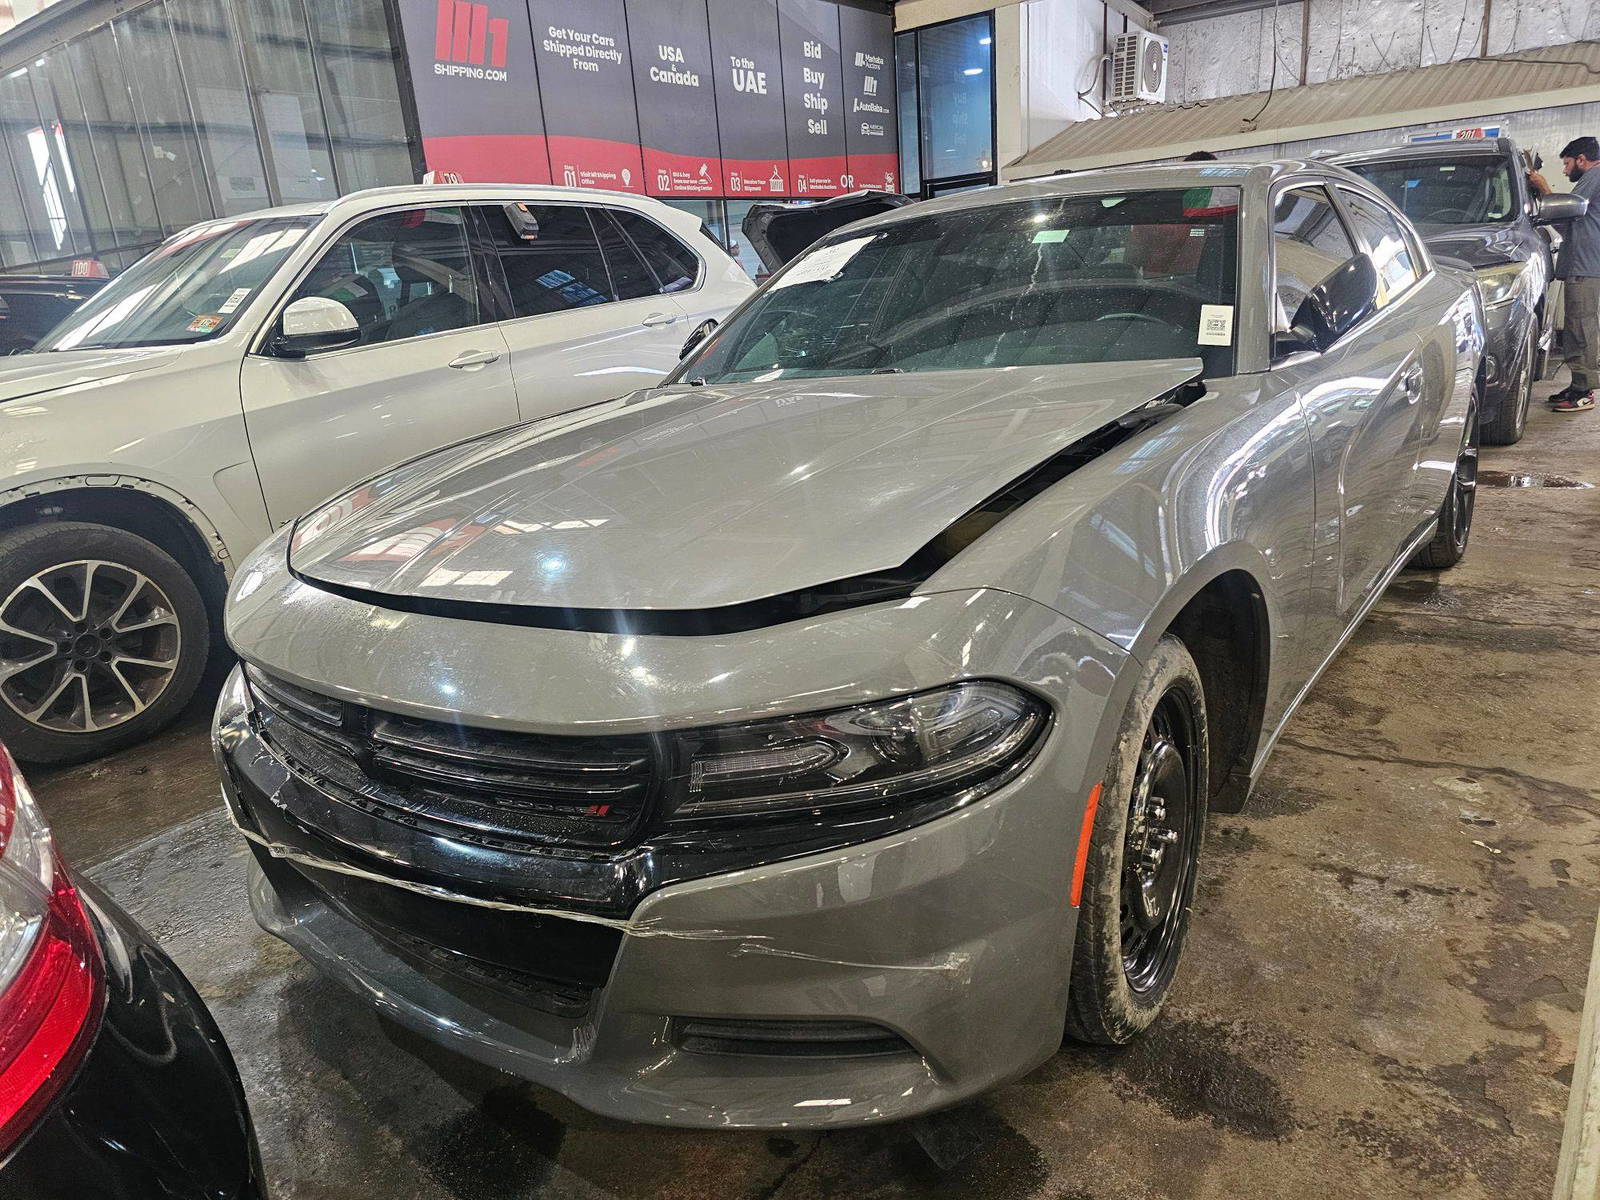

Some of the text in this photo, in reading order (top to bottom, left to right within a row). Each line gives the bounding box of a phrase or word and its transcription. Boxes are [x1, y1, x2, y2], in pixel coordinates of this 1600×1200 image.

[548, 26, 615, 47] Get Your Cars
[543, 39, 623, 65] Shipped Directly
[658, 45, 685, 63] USA
[803, 40, 822, 59] Bid
[573, 58, 599, 72] From
[730, 56, 755, 69] To the
[434, 63, 508, 82] SHIPPING.COM
[649, 66, 700, 87] Canada
[803, 67, 825, 90] Buy
[732, 68, 767, 95] UAE
[803, 92, 828, 115] Ship
[807, 118, 828, 135] Sell
[1461, 129, 1476, 140] 201
[564, 171, 577, 187] 01
[658, 174, 670, 191] 02
[730, 177, 741, 192] 03
[797, 180, 807, 192] 04
[840, 174, 854, 188] OR
